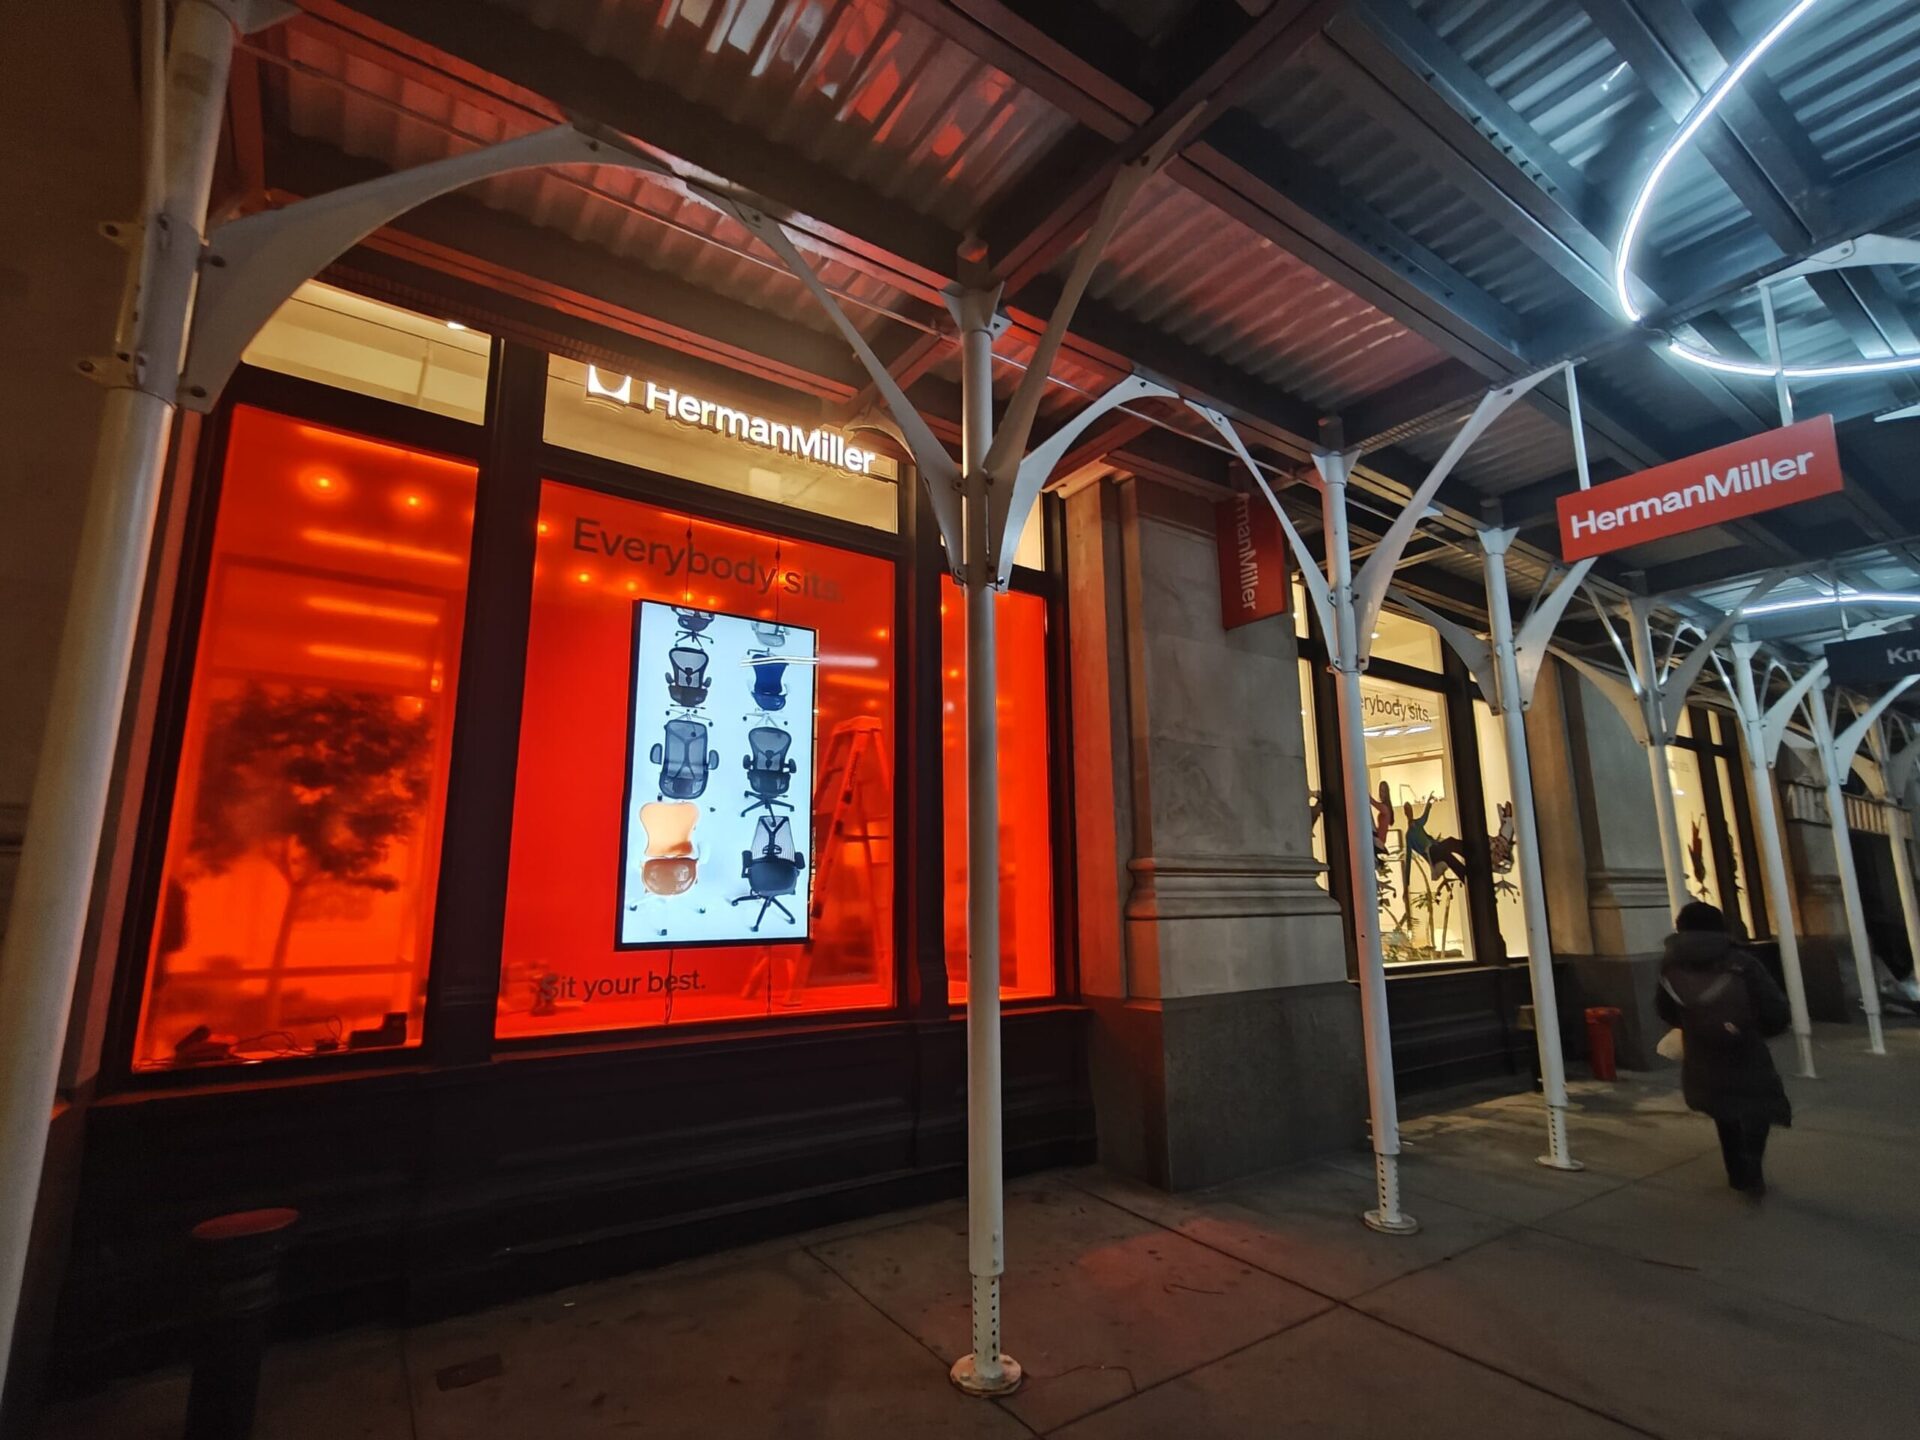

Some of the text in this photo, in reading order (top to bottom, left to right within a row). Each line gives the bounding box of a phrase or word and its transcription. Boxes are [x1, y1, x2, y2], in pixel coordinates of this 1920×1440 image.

[646, 382, 876, 474] HermanMiller
[1570, 451, 1815, 539] HermanMiller
[573, 516, 778, 593] Everybody
[583, 975, 642, 1003] your
[647, 970, 706, 993] best.
